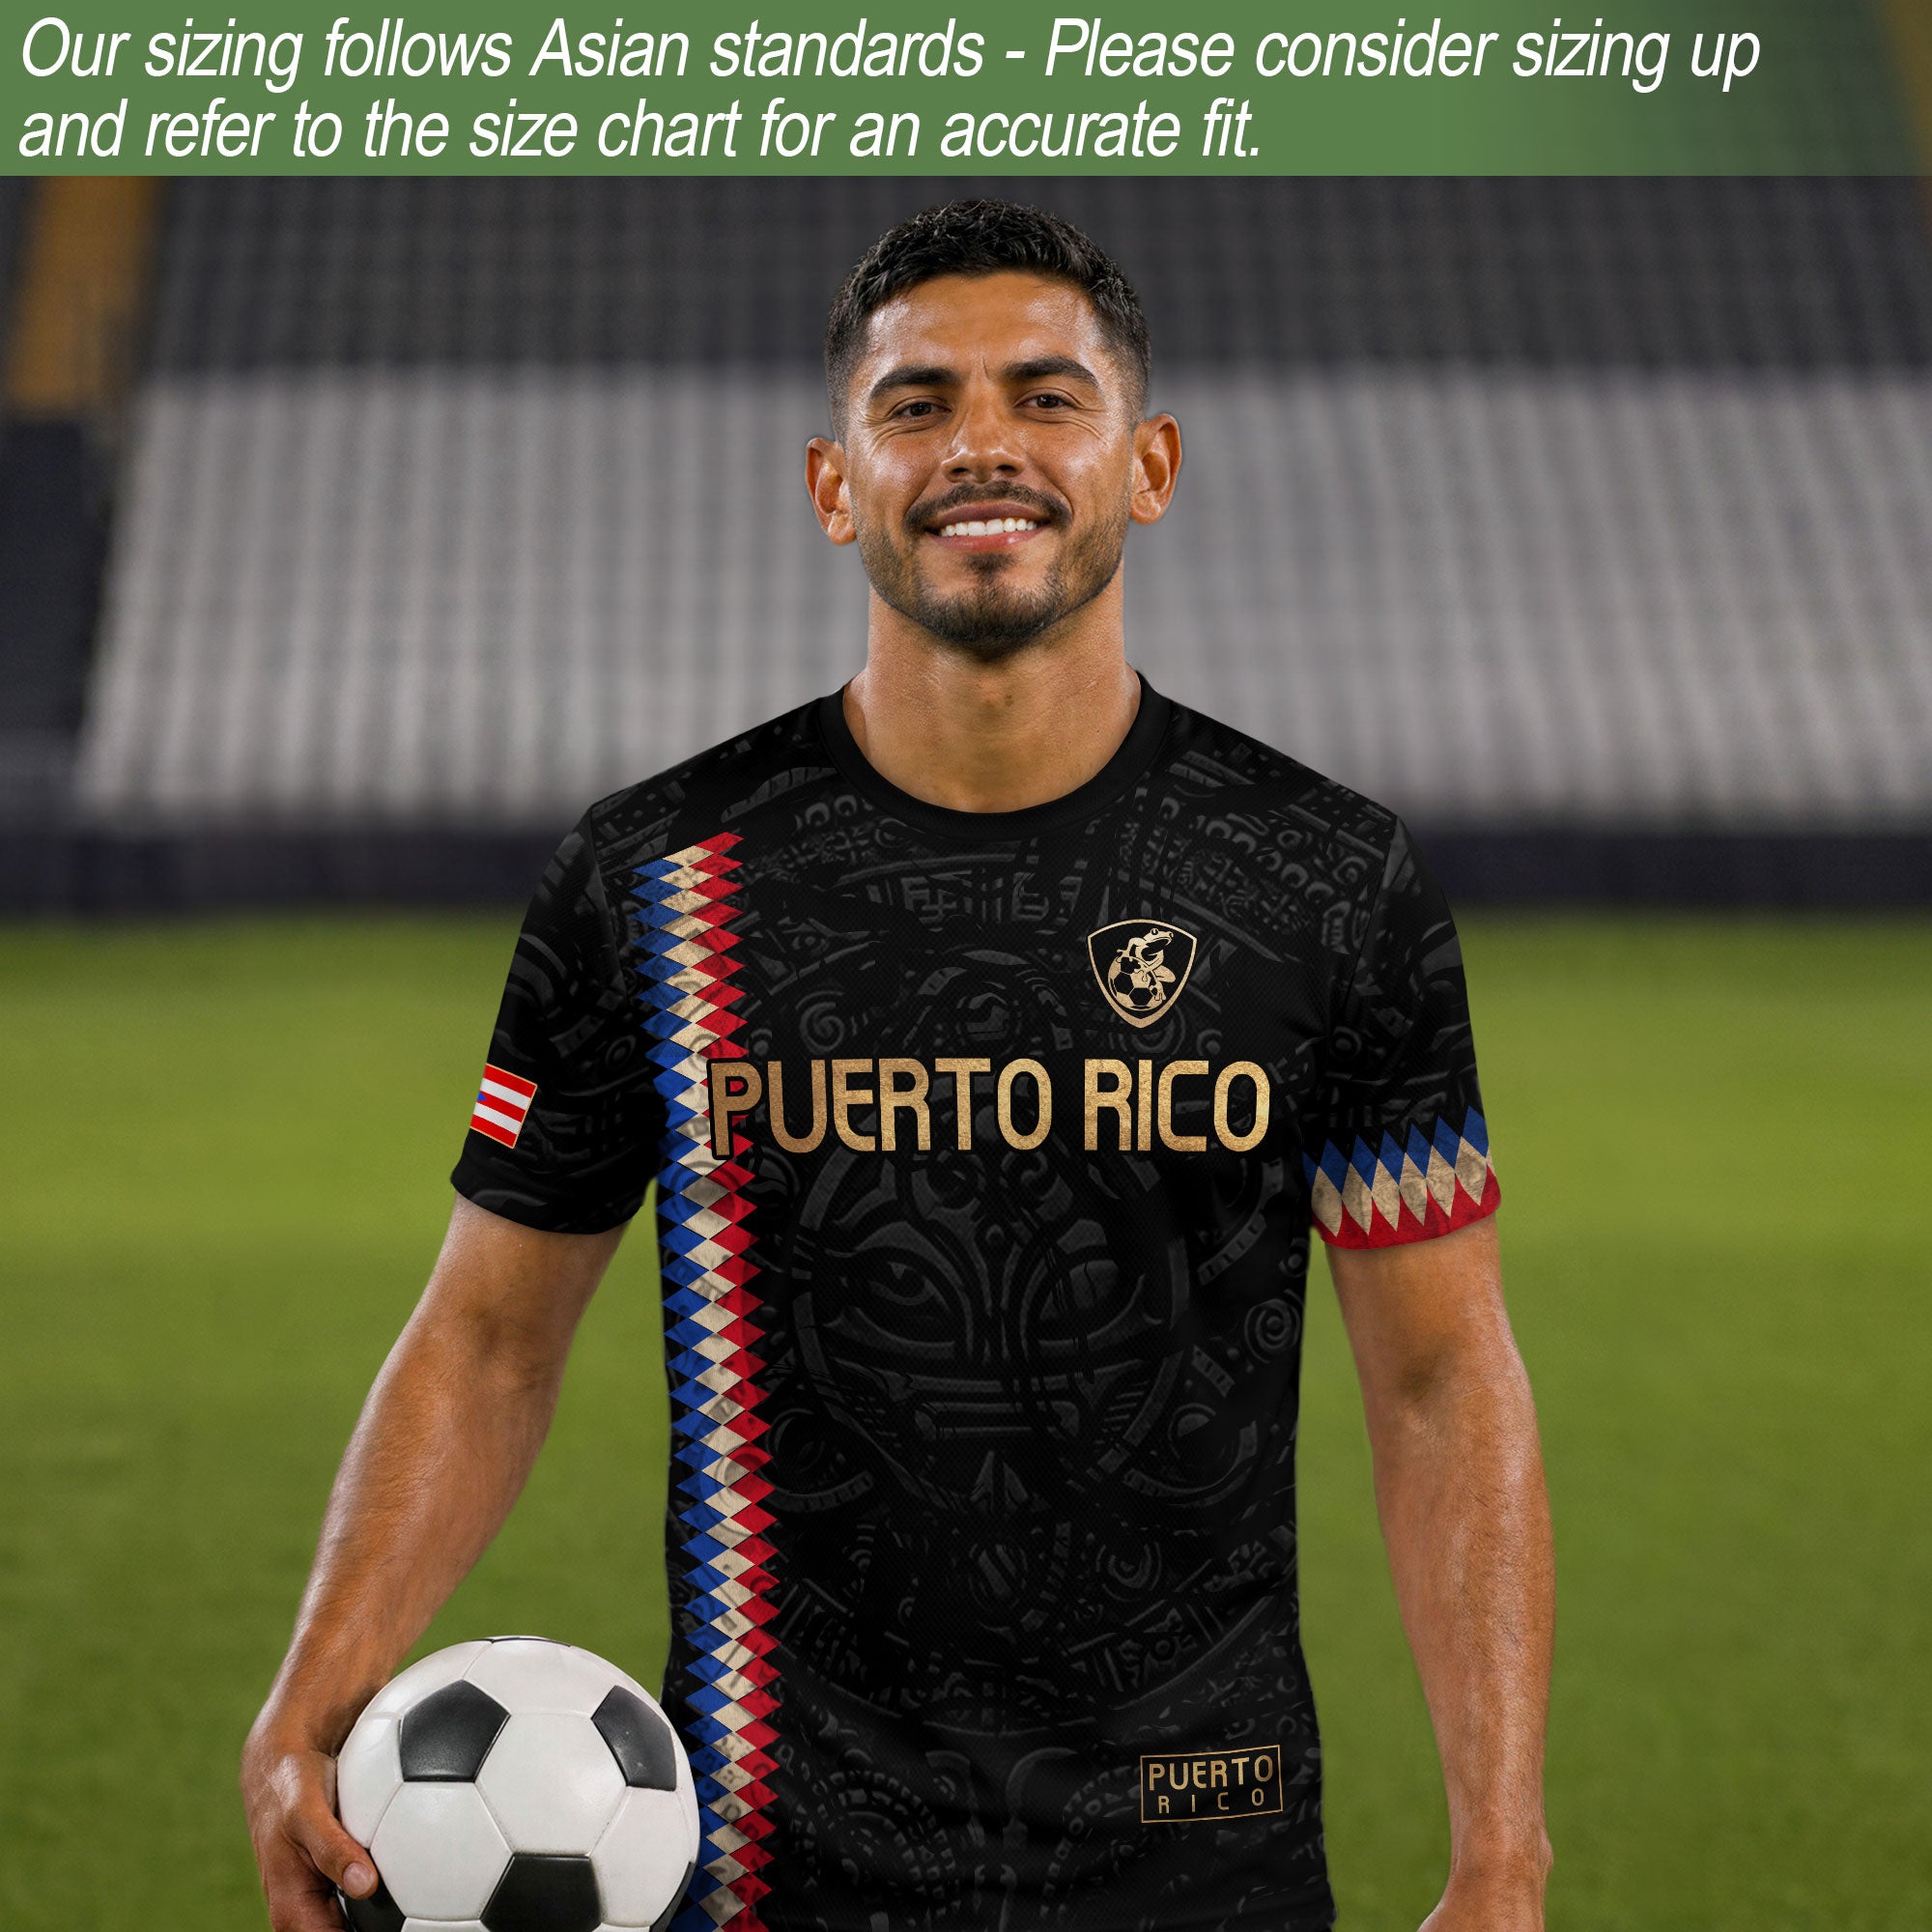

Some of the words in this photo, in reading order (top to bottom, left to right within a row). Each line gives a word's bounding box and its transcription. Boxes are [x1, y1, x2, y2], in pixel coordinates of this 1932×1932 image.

[711, 1058, 1052, 1155] PUERTO
[1084, 1059, 1270, 1152] RICO
[1149, 1754, 1273, 1791] PUERTO
[1158, 1788, 1264, 1813] RICO
